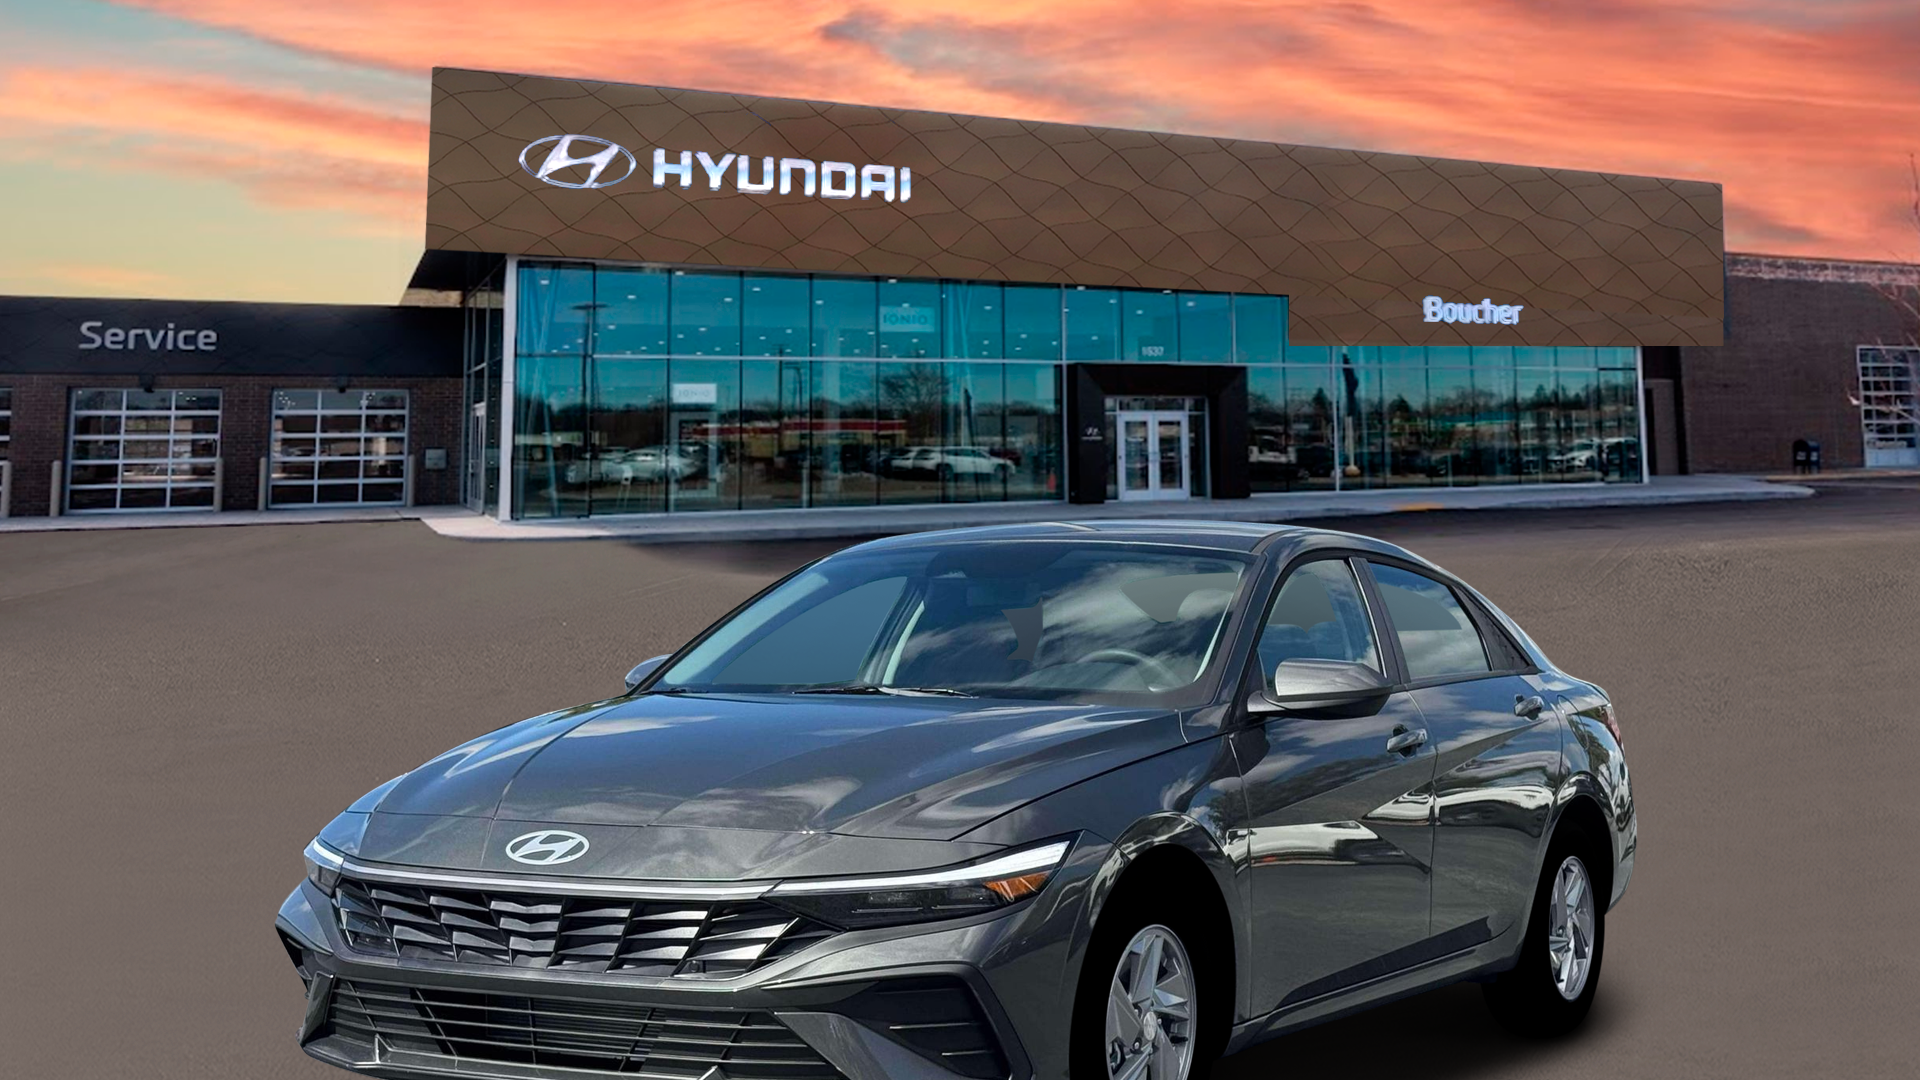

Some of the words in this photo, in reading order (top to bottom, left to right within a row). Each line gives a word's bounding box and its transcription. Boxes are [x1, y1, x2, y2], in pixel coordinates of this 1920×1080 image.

[653, 148, 911, 202] HYUNDAI
[1422, 295, 1524, 325] Boucher
[78, 321, 217, 350] Service
